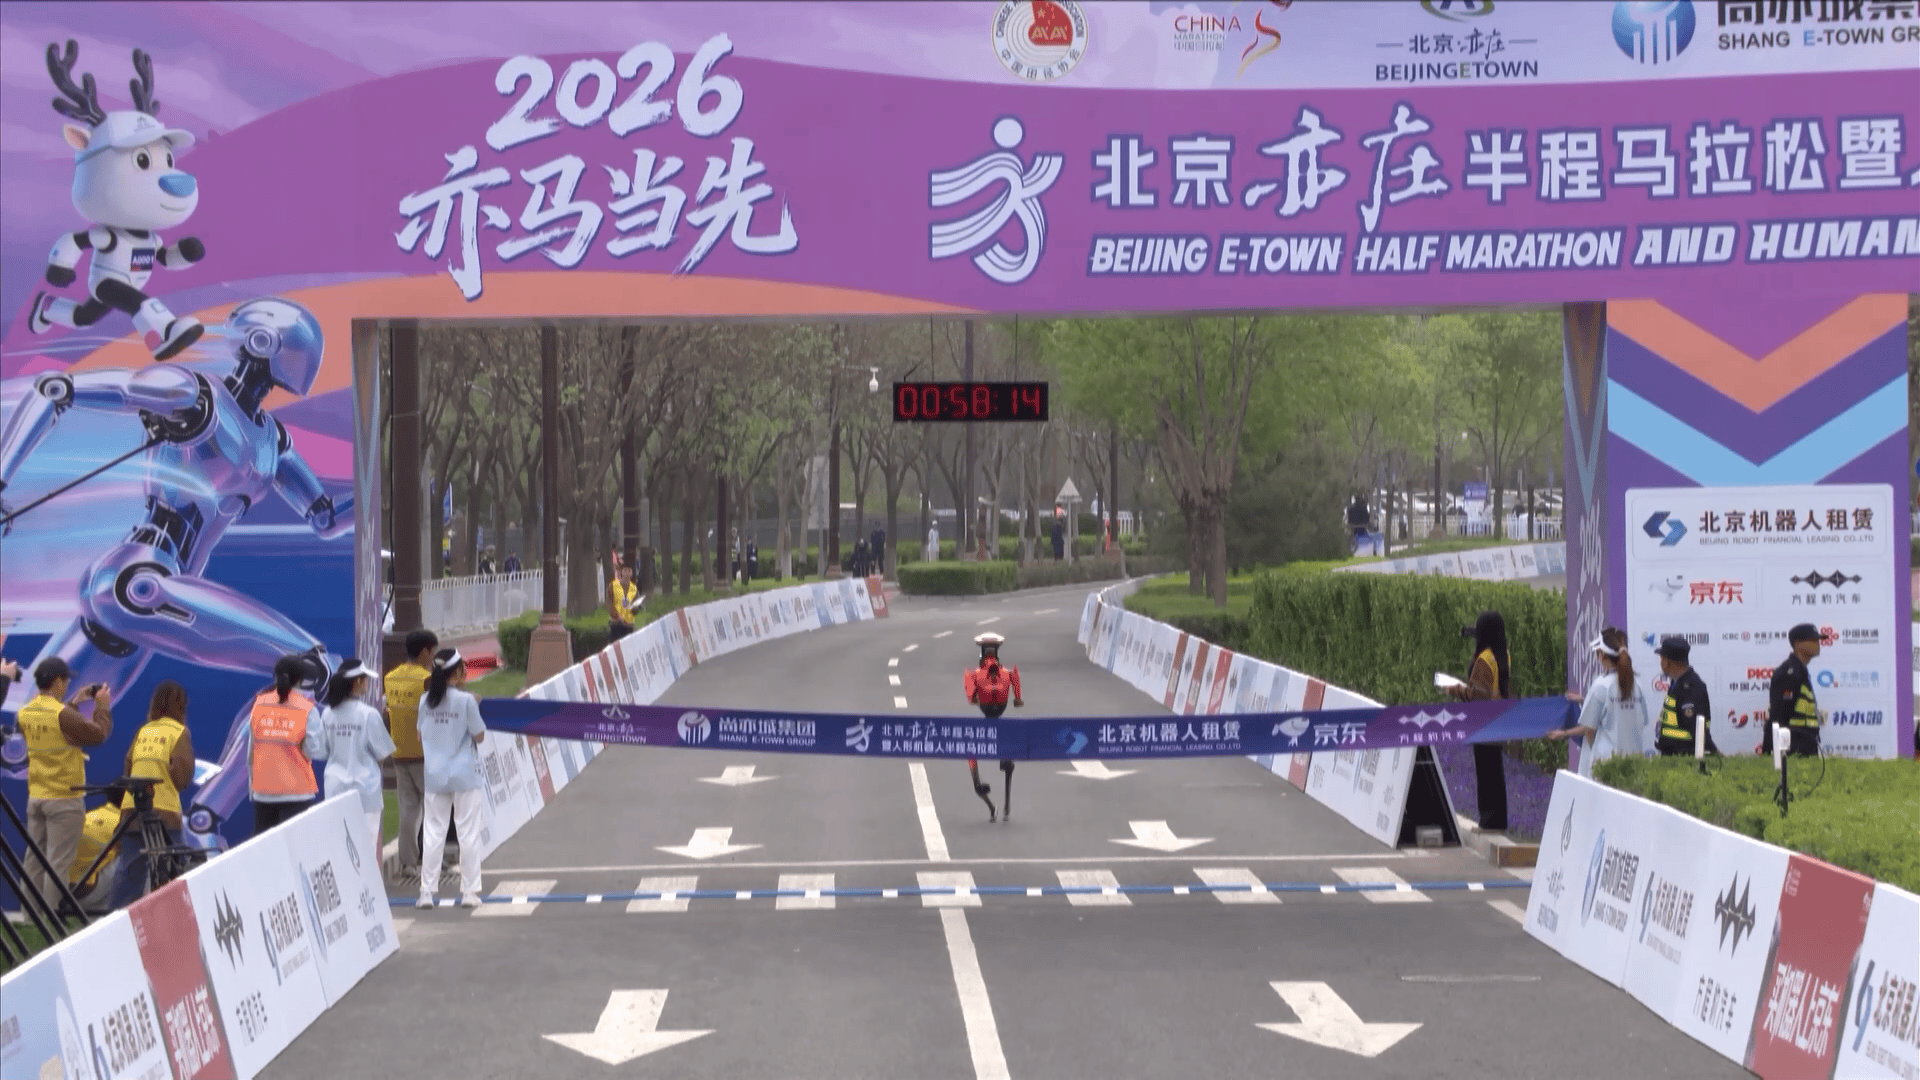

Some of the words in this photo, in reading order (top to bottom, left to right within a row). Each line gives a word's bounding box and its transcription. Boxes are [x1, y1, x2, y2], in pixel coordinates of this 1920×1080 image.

[1174, 15, 1242, 32] CHINA
[1718, 31, 1791, 50] SHANG
[1803, 27, 1882, 46] E-TOWN
[1376, 61, 1537, 83] BEIJINGETOWN
[486, 32, 744, 151] 2026
[1095, 104, 1920, 232] 北京亦庄半程马拉松暨
[395, 137, 798, 301] 亦马当先
[1091, 237, 1208, 273] BEIJING
[1219, 236, 1342, 272] E-TOWN
[1356, 233, 1439, 271] HALF
[1445, 230, 1622, 270] MARATHON
[1634, 226, 1736, 265] AND
[1699, 508, 1874, 534] 北京机器人租赁
[1579, 498, 1602, 594] 2026
[1699, 536, 1729, 545] BEIJING
[1733, 536, 1759, 544] ROBOT
[1763, 535, 1803, 543] FINANCIAL
[1807, 534, 1840, 543] LEASING
[1689, 581, 1743, 605] 京东
[718, 717, 814, 737] 尚亦城集团
[1833, 710, 1883, 725] 补水啦
[582, 732, 645, 744] BEIJINGETOWN
[718, 734, 745, 743] SHANG
[751, 736, 782, 745] E-TOWN
[786, 737, 815, 746] GROUP
[1098, 721, 1239, 743] 北京机器人租赁
[1313, 722, 1367, 746] 京东
[1098, 745, 1123, 753] BEIJING
[1125, 745, 1148, 753] ROBOT
[1150, 744, 1183, 752] FINANCIAL
[1599, 844, 1639, 904] 尚亦城集团
[1652, 876, 1694, 939] 北京机器人租赁
[267, 891, 304, 954] 北京机器人租赁
[1693, 973, 1738, 1034] 方程豹汽车
[1763, 962, 1839, 1059] 买机器人上京东
[1872, 969, 1920, 1050] 北京机器人
[102, 991, 157, 1075] 北京机器人租赁
